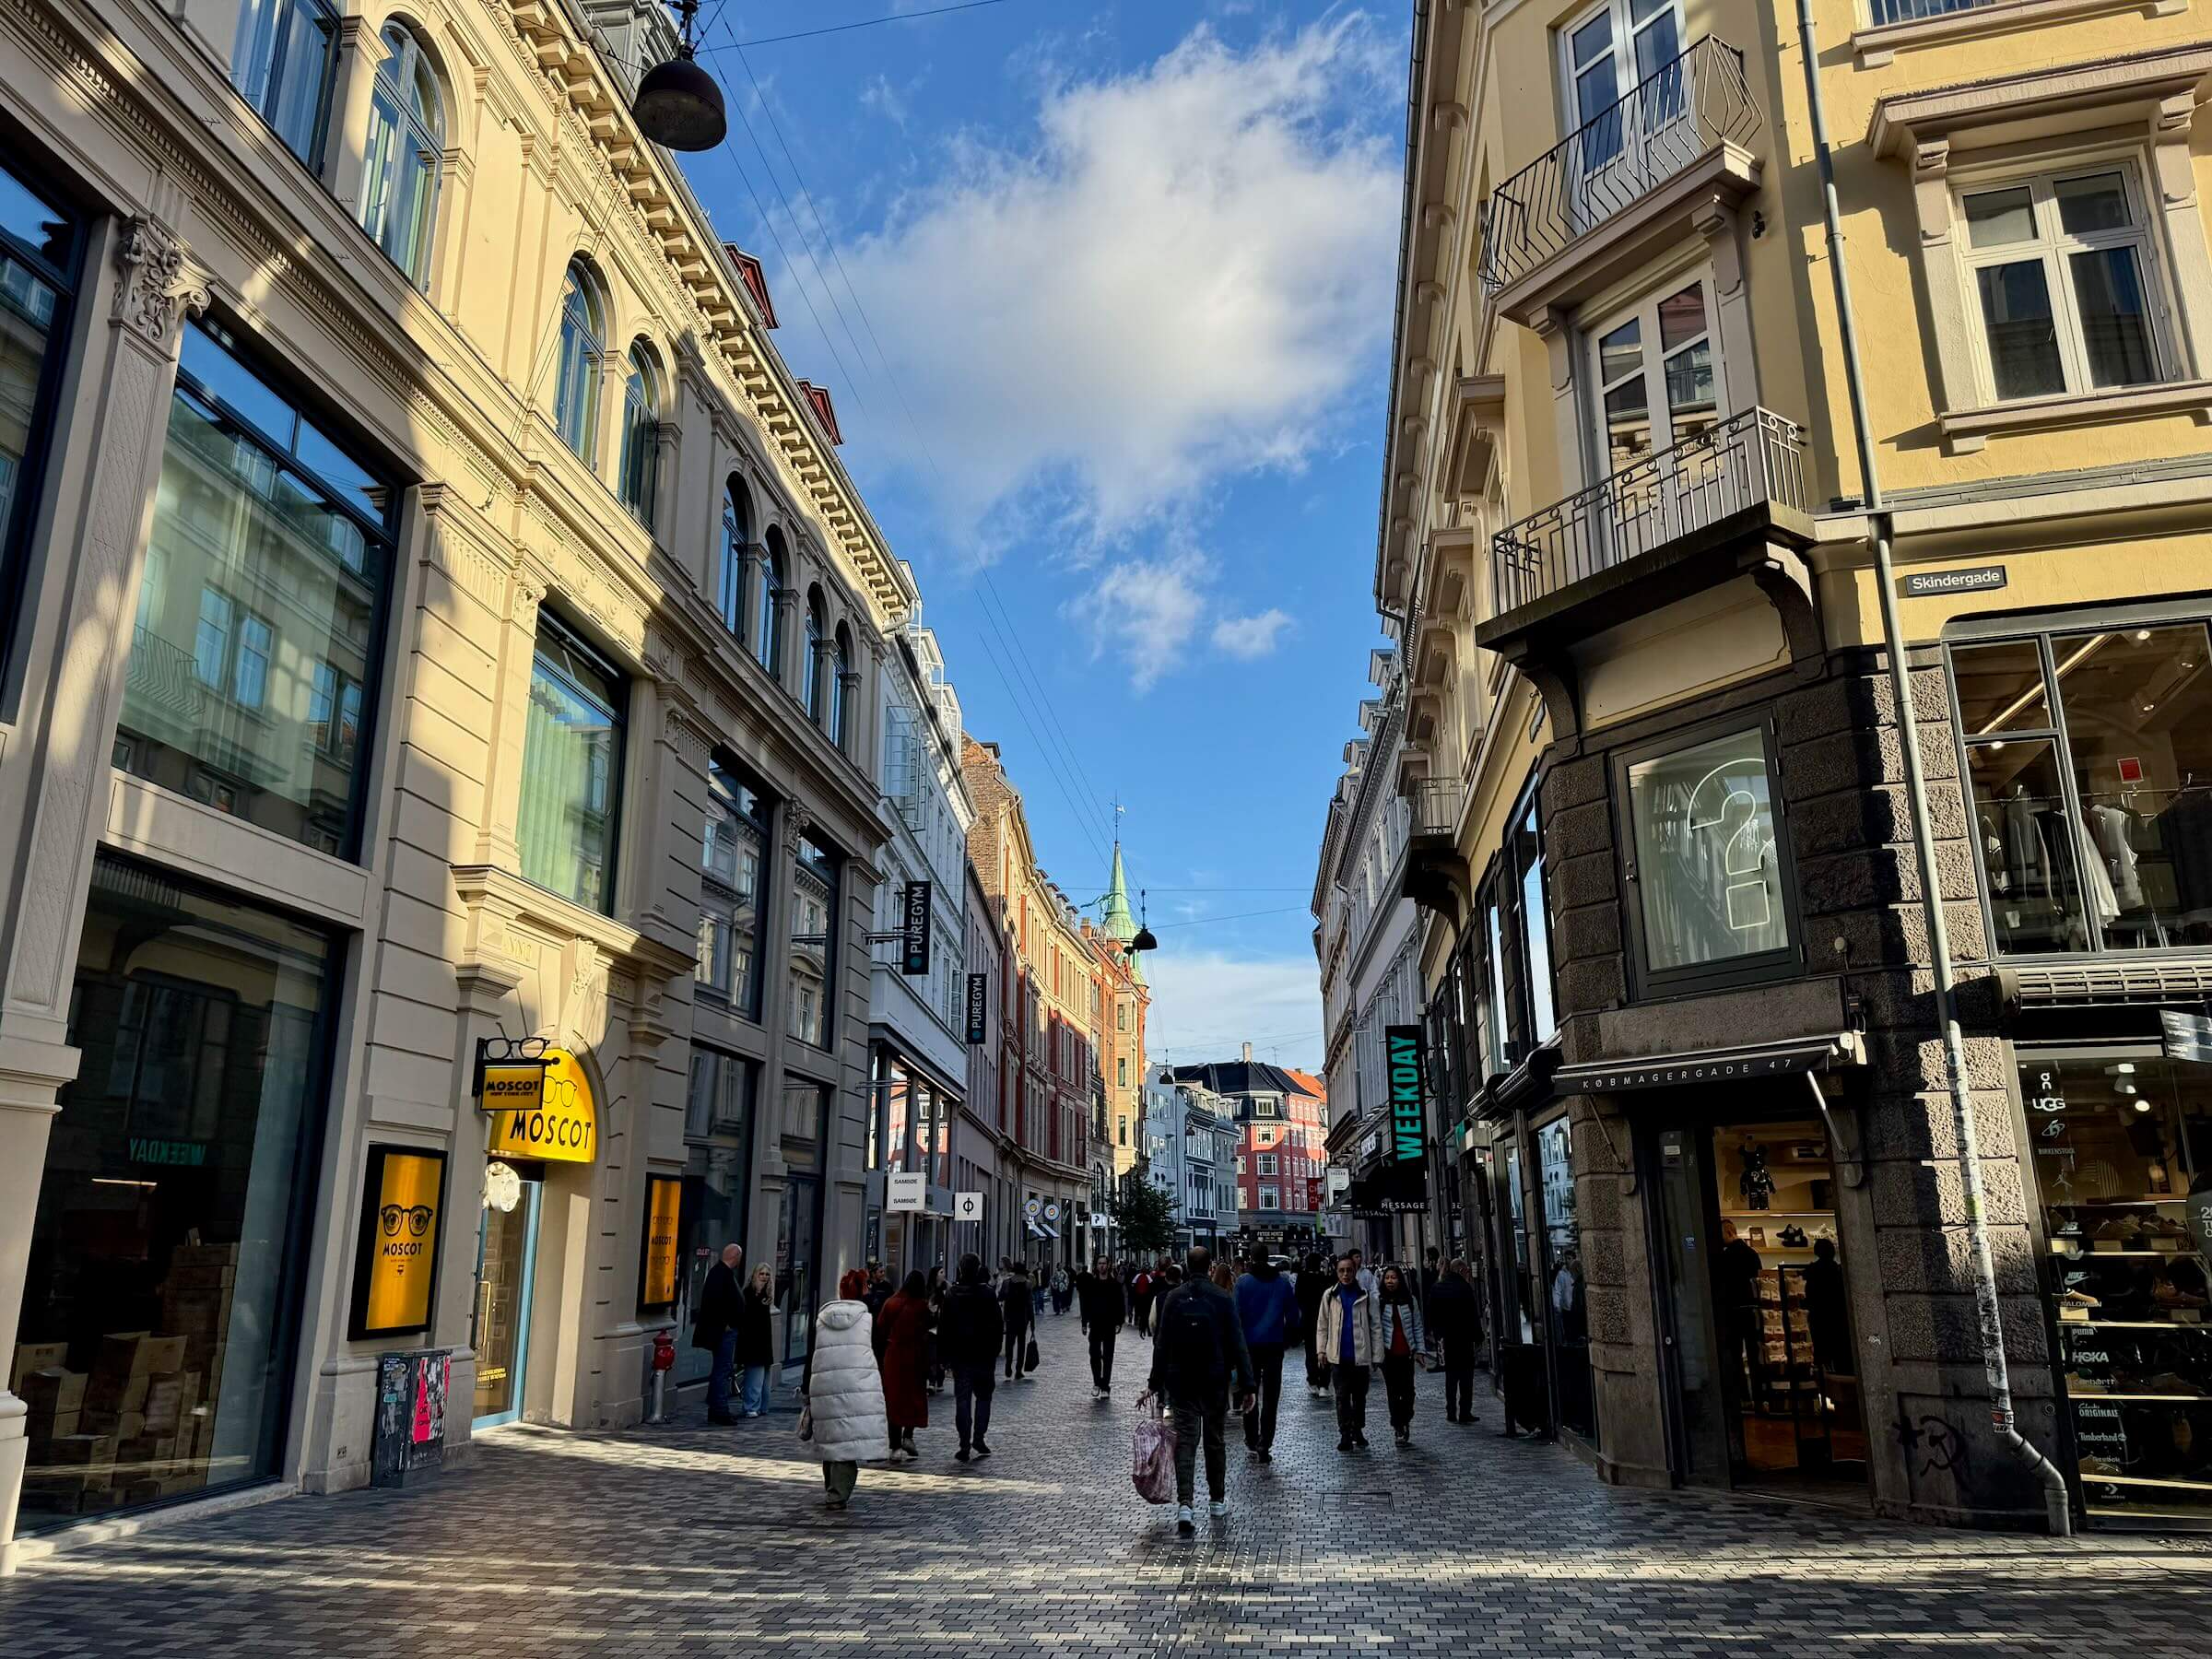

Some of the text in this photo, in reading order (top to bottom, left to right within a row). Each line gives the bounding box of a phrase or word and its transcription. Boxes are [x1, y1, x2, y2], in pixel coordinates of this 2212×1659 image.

[1912, 571, 1999, 589] Skindergade
[910, 886, 924, 954] PUREGYM
[972, 977, 982, 1029] PUREGYM
[486, 1080, 539, 1091] MOSCOT
[1583, 1059, 1791, 1089] KØBMAGERGADE 47
[1391, 1036, 1423, 1161] WEEKDAY
[2032, 1098, 2066, 1112] UGG
[510, 1111, 592, 1149] MOSCOT
[382, 1243, 423, 1256] MOSCOT
[2072, 1350, 2110, 1362] HOKA
